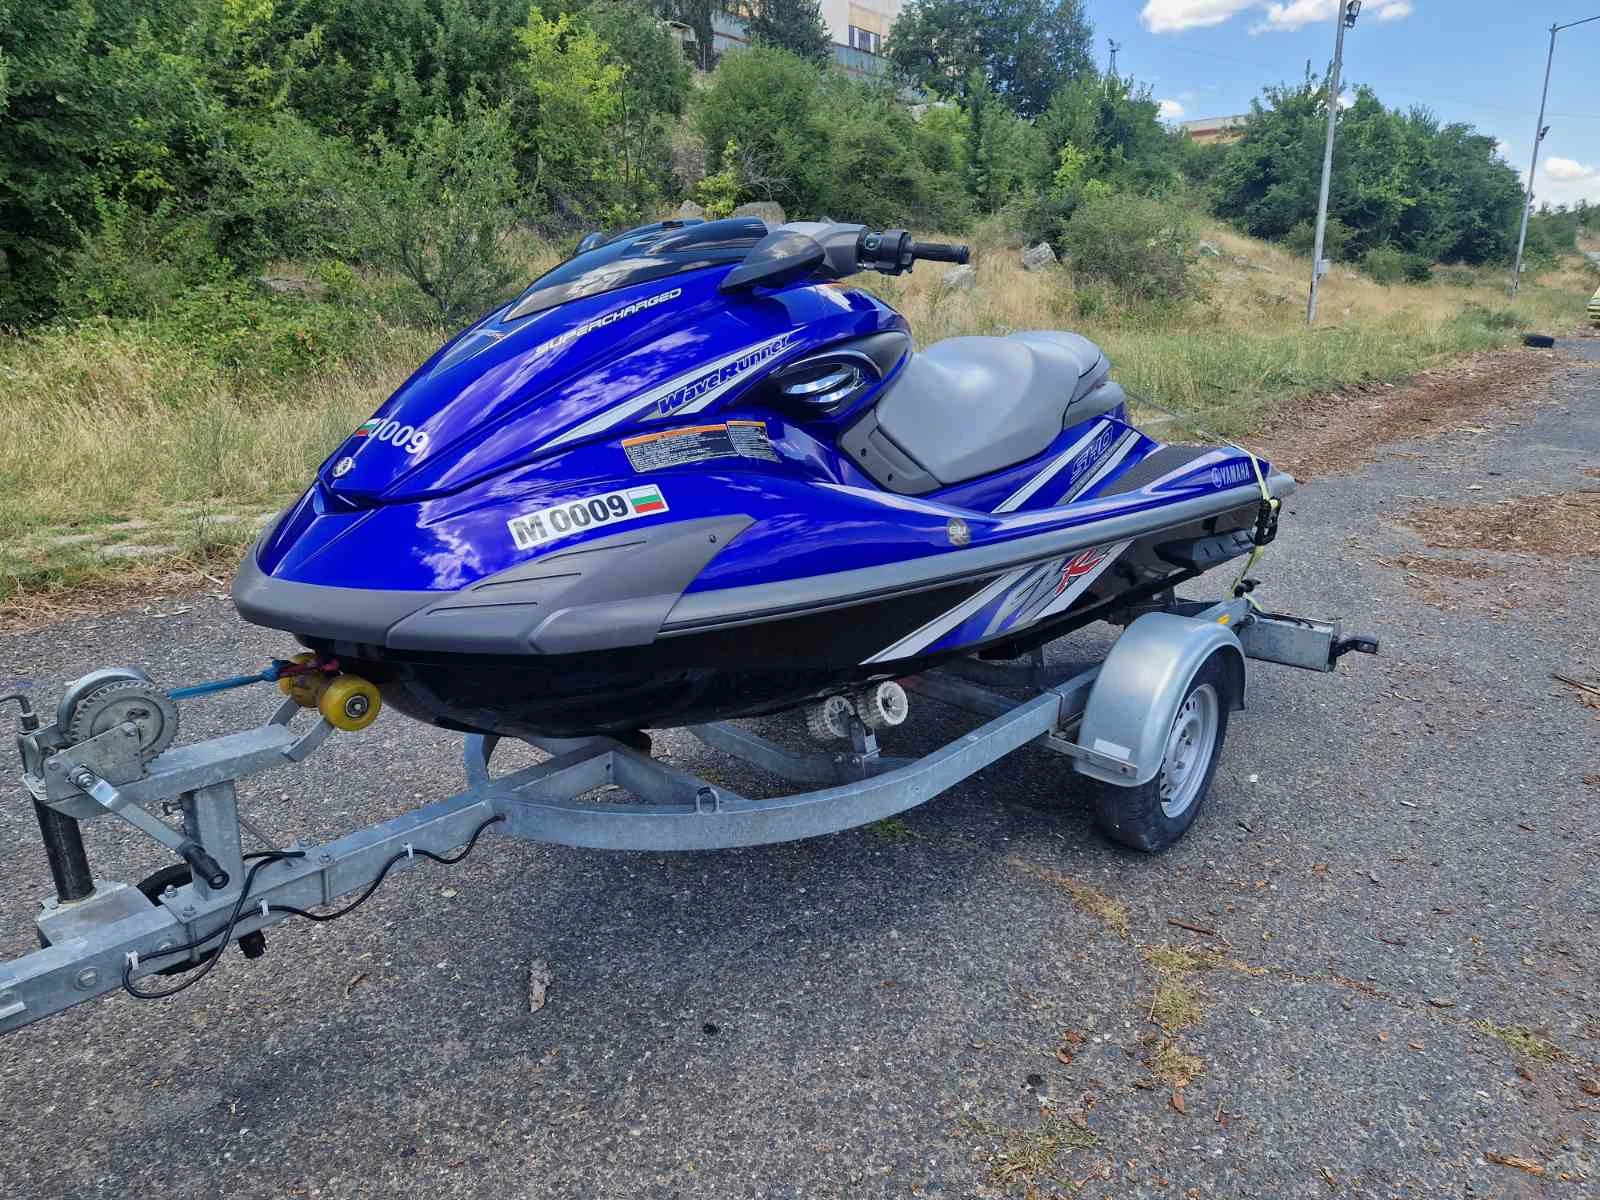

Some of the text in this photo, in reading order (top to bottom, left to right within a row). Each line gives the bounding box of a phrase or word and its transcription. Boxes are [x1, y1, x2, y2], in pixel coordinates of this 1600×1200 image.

[534, 287, 682, 355] SUPERCHARGED
[656, 334, 793, 417] WaveRunner
[1219, 462, 1250, 485] YAMAHA
[511, 493, 629, 546] M 0009
